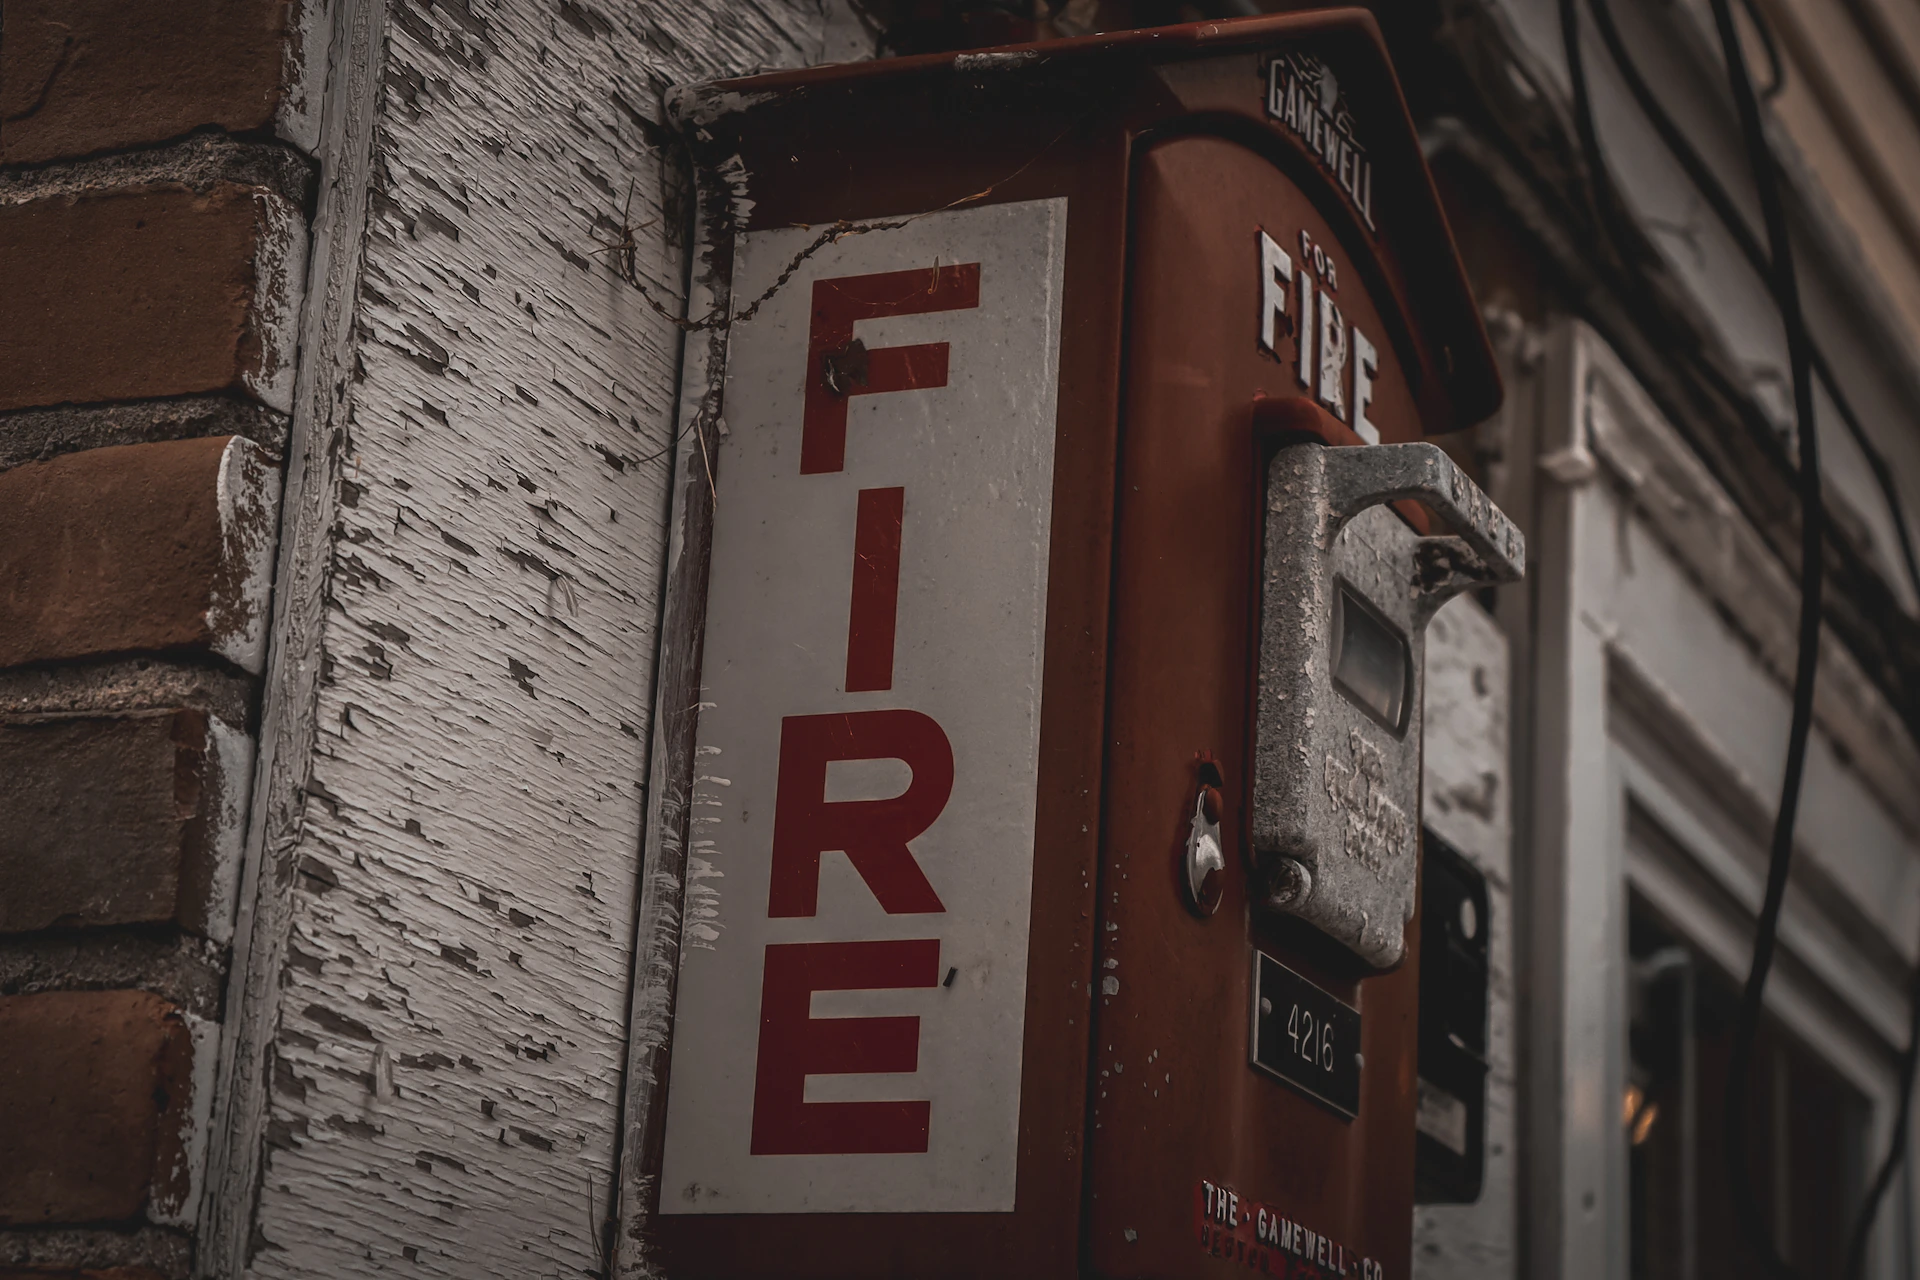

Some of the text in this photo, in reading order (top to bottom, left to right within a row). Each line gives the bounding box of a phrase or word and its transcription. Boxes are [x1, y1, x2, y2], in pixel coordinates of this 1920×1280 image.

[1269, 59, 1376, 232] GAMEWELL
[1301, 229, 1338, 291] FOR
[1260, 230, 1380, 445] FIRE
[750, 262, 981, 1156] FIRE
[1287, 1003, 1335, 1073] 4216
[1202, 1179, 1239, 1227] THE
[1257, 1207, 1347, 1277] GAMEWELL
